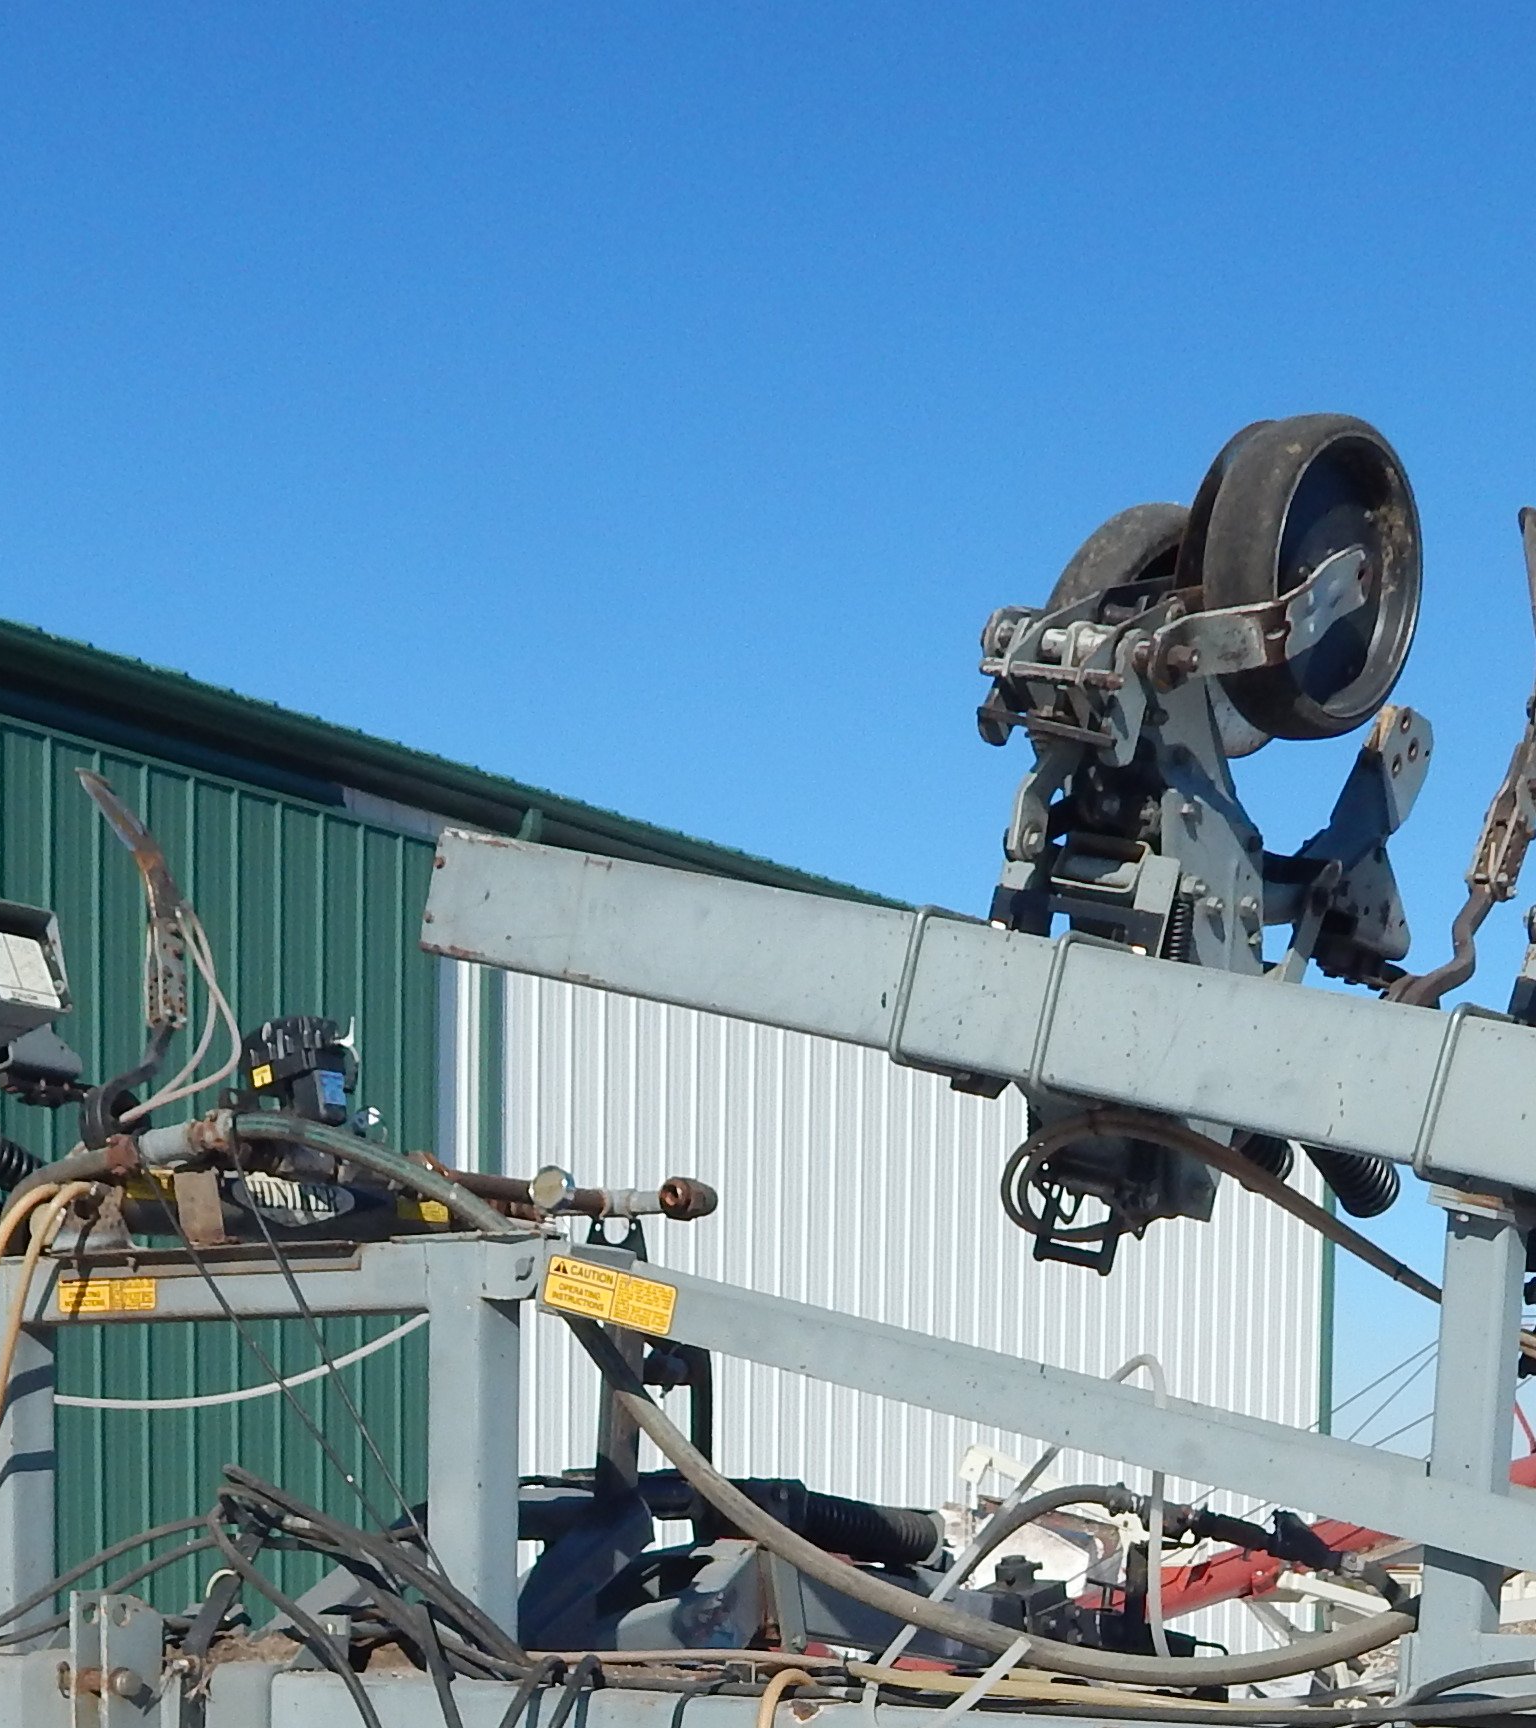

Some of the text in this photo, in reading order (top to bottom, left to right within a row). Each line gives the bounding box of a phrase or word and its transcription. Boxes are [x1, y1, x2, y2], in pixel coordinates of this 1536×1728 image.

[570, 1265, 613, 1285] CAUTION
[559, 1282, 601, 1300] OPERATING
[552, 1291, 605, 1312] INSTRUCTIONS
